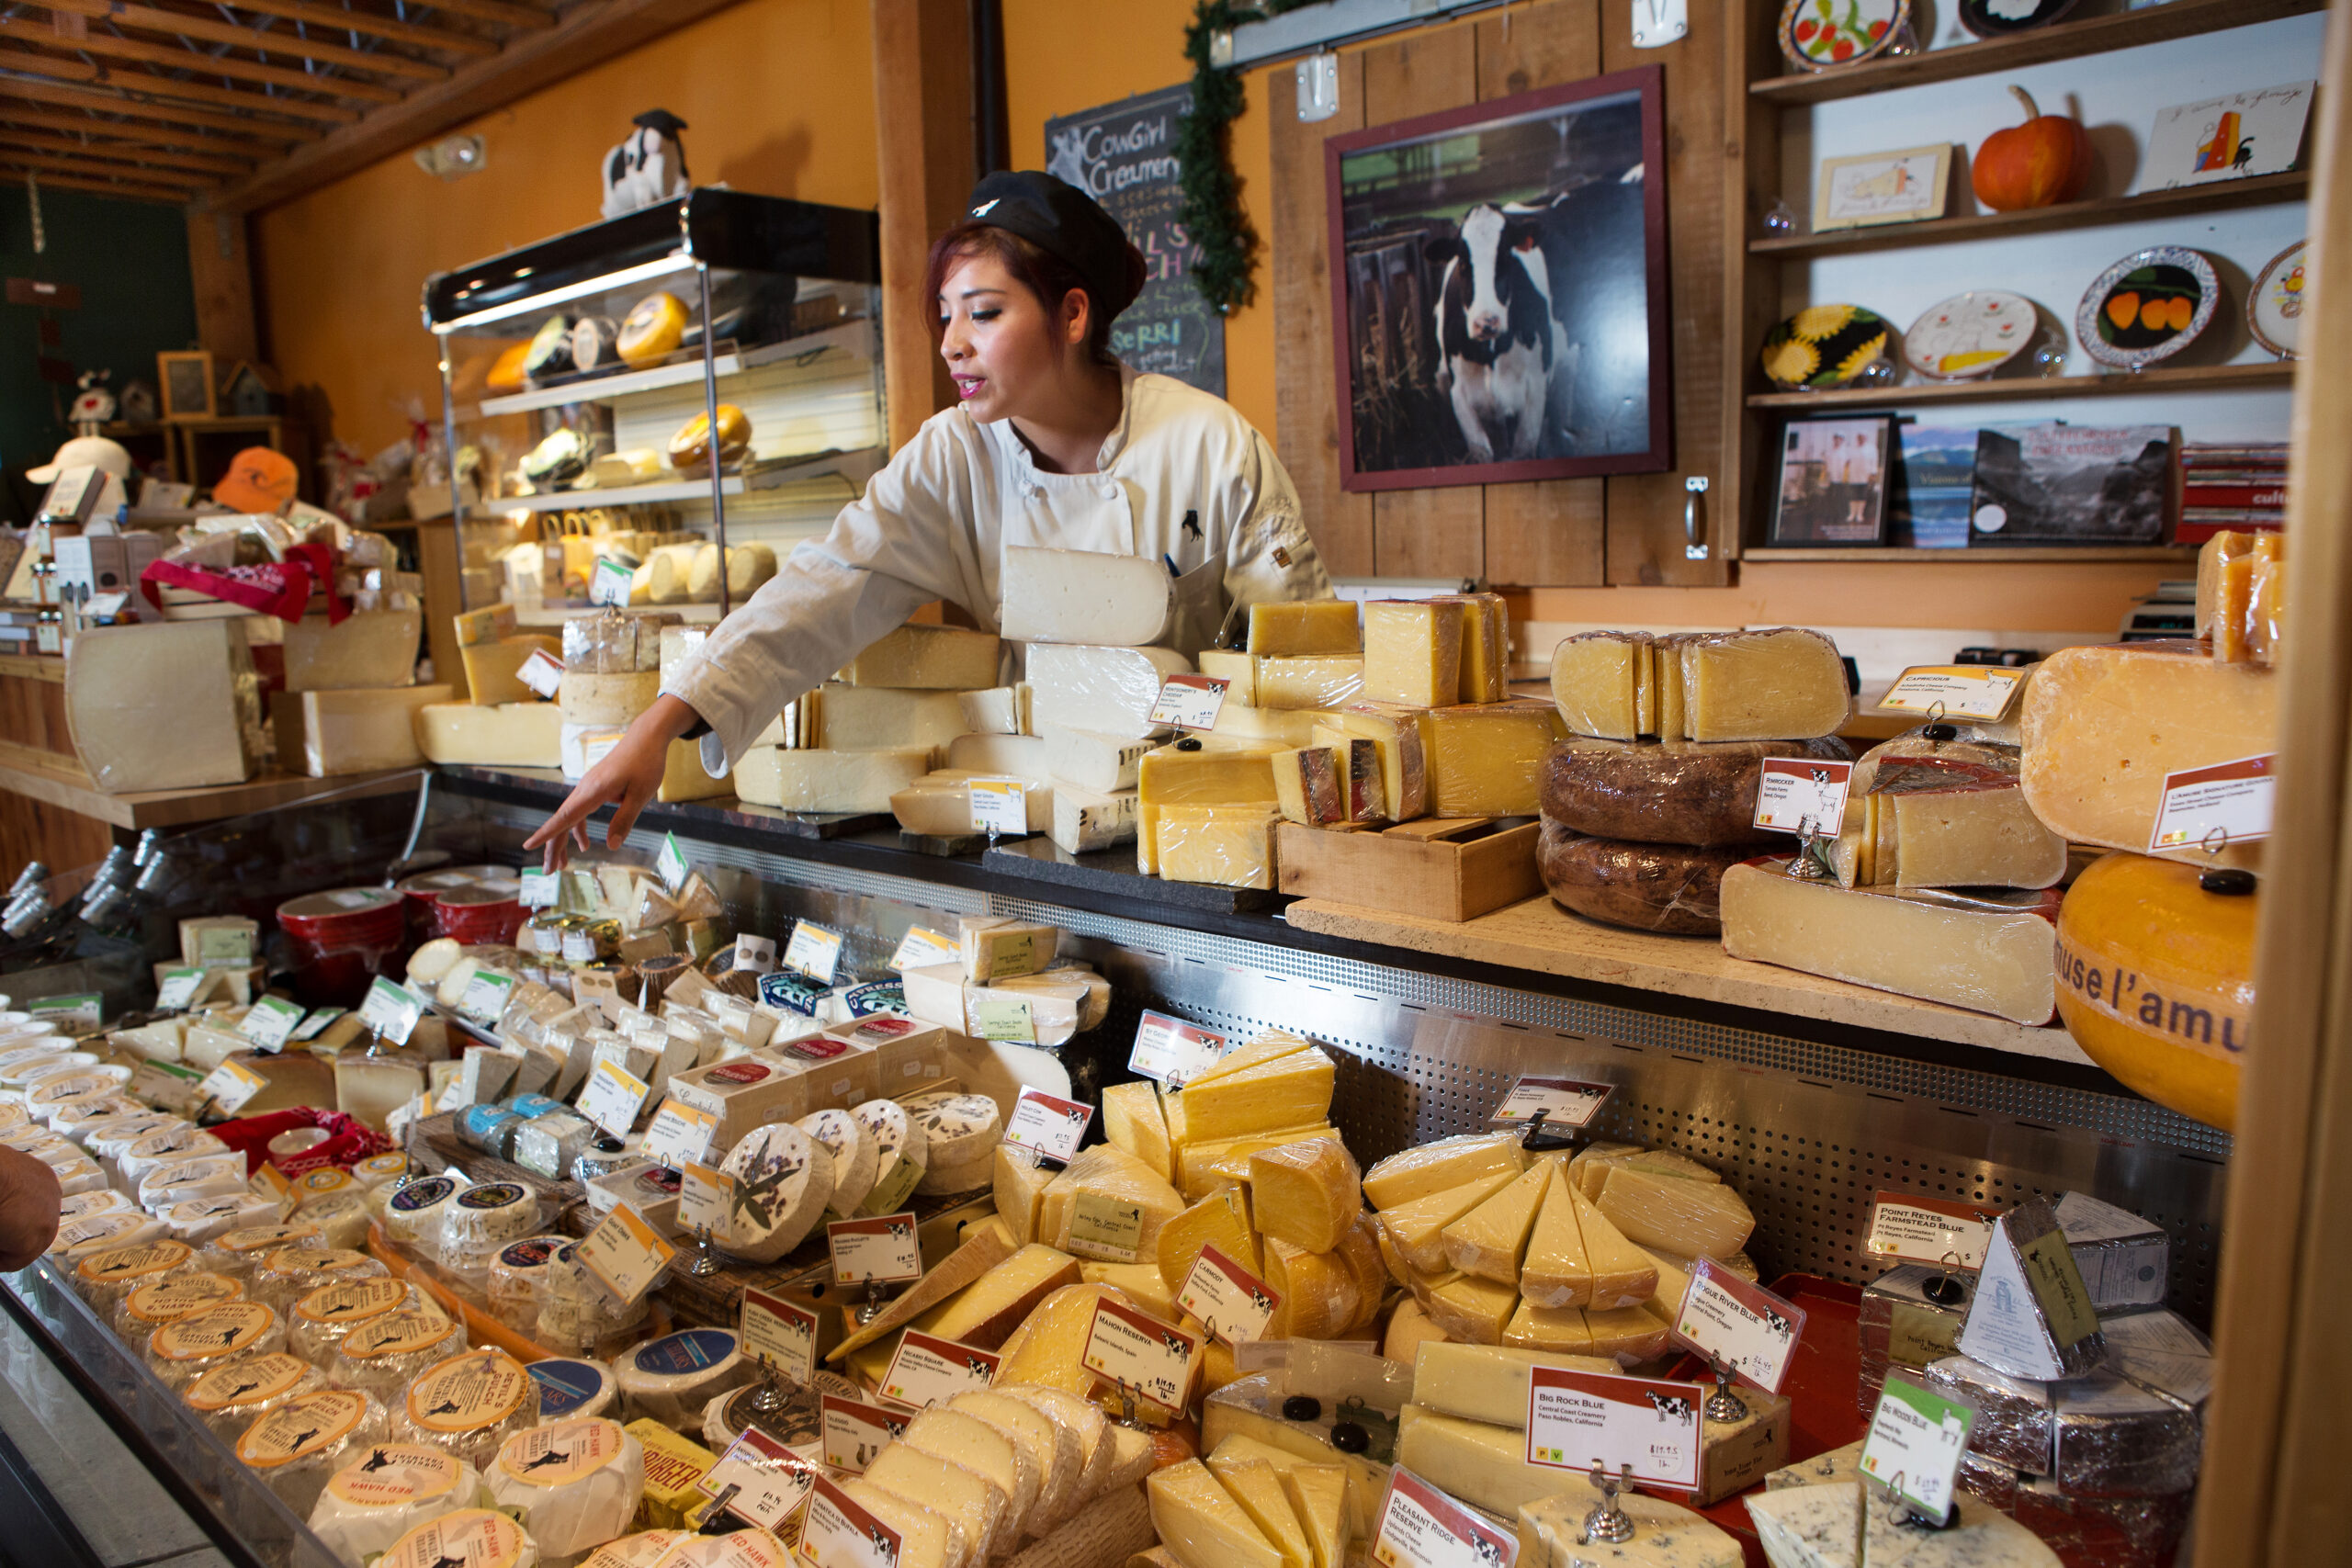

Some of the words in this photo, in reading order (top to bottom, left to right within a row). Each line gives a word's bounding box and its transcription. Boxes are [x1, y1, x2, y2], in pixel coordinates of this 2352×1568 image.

[1880, 1214, 1936, 1228] FARMSTEAD
[1939, 1223, 1964, 1233] BLUE
[1881, 1207, 1909, 1217] POINT
[1911, 1212, 1942, 1222] REYES
[1885, 1224, 1903, 1233] Reyes
[1905, 1234, 1933, 1243] California
[1199, 1262, 1224, 1283] CARMODY
[1705, 1300, 1725, 1317] Creamery
[1719, 1294, 1739, 1312] RIVER
[1740, 1307, 1759, 1325] BLUE
[1098, 1315, 1122, 1333] MAHON
[1123, 1326, 1152, 1347] RESERVA
[1716, 1317, 1733, 1331] Oregon
[1125, 1348, 1136, 1358] Spain
[482, 1373, 503, 1406] GULCH
[495, 1371, 515, 1409] DEVIL'S
[1540, 1393, 1554, 1404] BIG
[1556, 1396, 1579, 1405] ROCK
[1582, 1400, 1605, 1410] BLUE
[1538, 1405, 1559, 1414] Central
[1560, 1407, 1576, 1416] Coast
[1577, 1410, 1606, 1420] Creamery
[1538, 1413, 1552, 1421] Paso
[1553, 1415, 1574, 1424] Robles,
[1575, 1417, 1603, 1427] California
[1882, 1402, 1892, 1416] BIG
[1912, 1416, 1928, 1430] BLUE
[841, 1520, 858, 1537] BUFALA
[1390, 1506, 1423, 1536] RESERVE
[1393, 1497, 1430, 1527] PLEASANT
[1431, 1524, 1455, 1545] RIDGE
[1386, 1520, 1405, 1536] Uplands
[1405, 1532, 1422, 1547] Cheese
[743, 1545, 771, 1567] HAWK
[1384, 1529, 1408, 1550] Dodgeville,
[1408, 1545, 1432, 1565] Wisconsin
